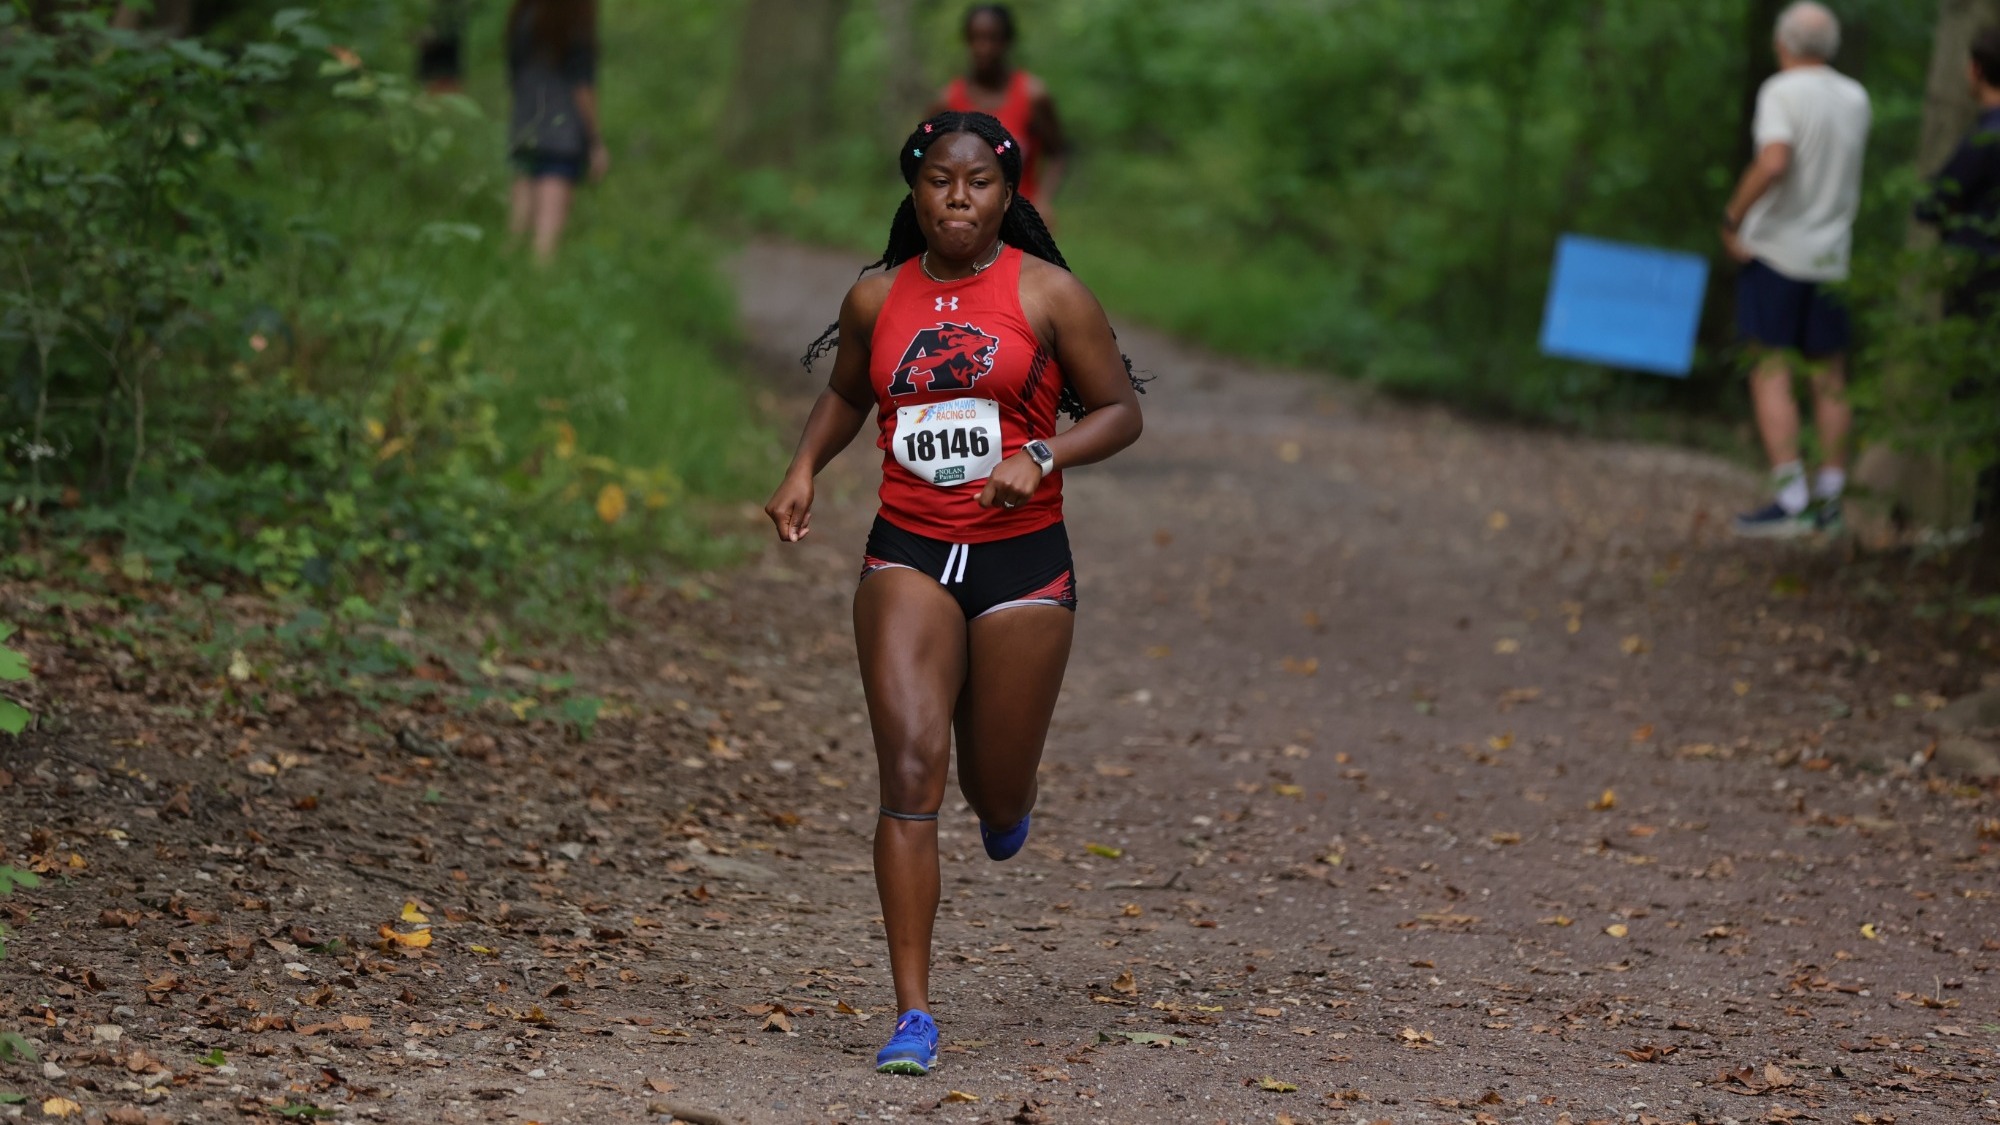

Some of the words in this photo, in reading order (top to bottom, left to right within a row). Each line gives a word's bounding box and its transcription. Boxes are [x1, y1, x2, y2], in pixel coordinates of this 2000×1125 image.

[937, 403, 953, 412] BRYN
[954, 400, 976, 410] MAWR
[936, 410, 964, 421] RACING
[965, 409, 976, 419] CO
[903, 427, 989, 461] 18146
[938, 467, 962, 475] NOLAN
